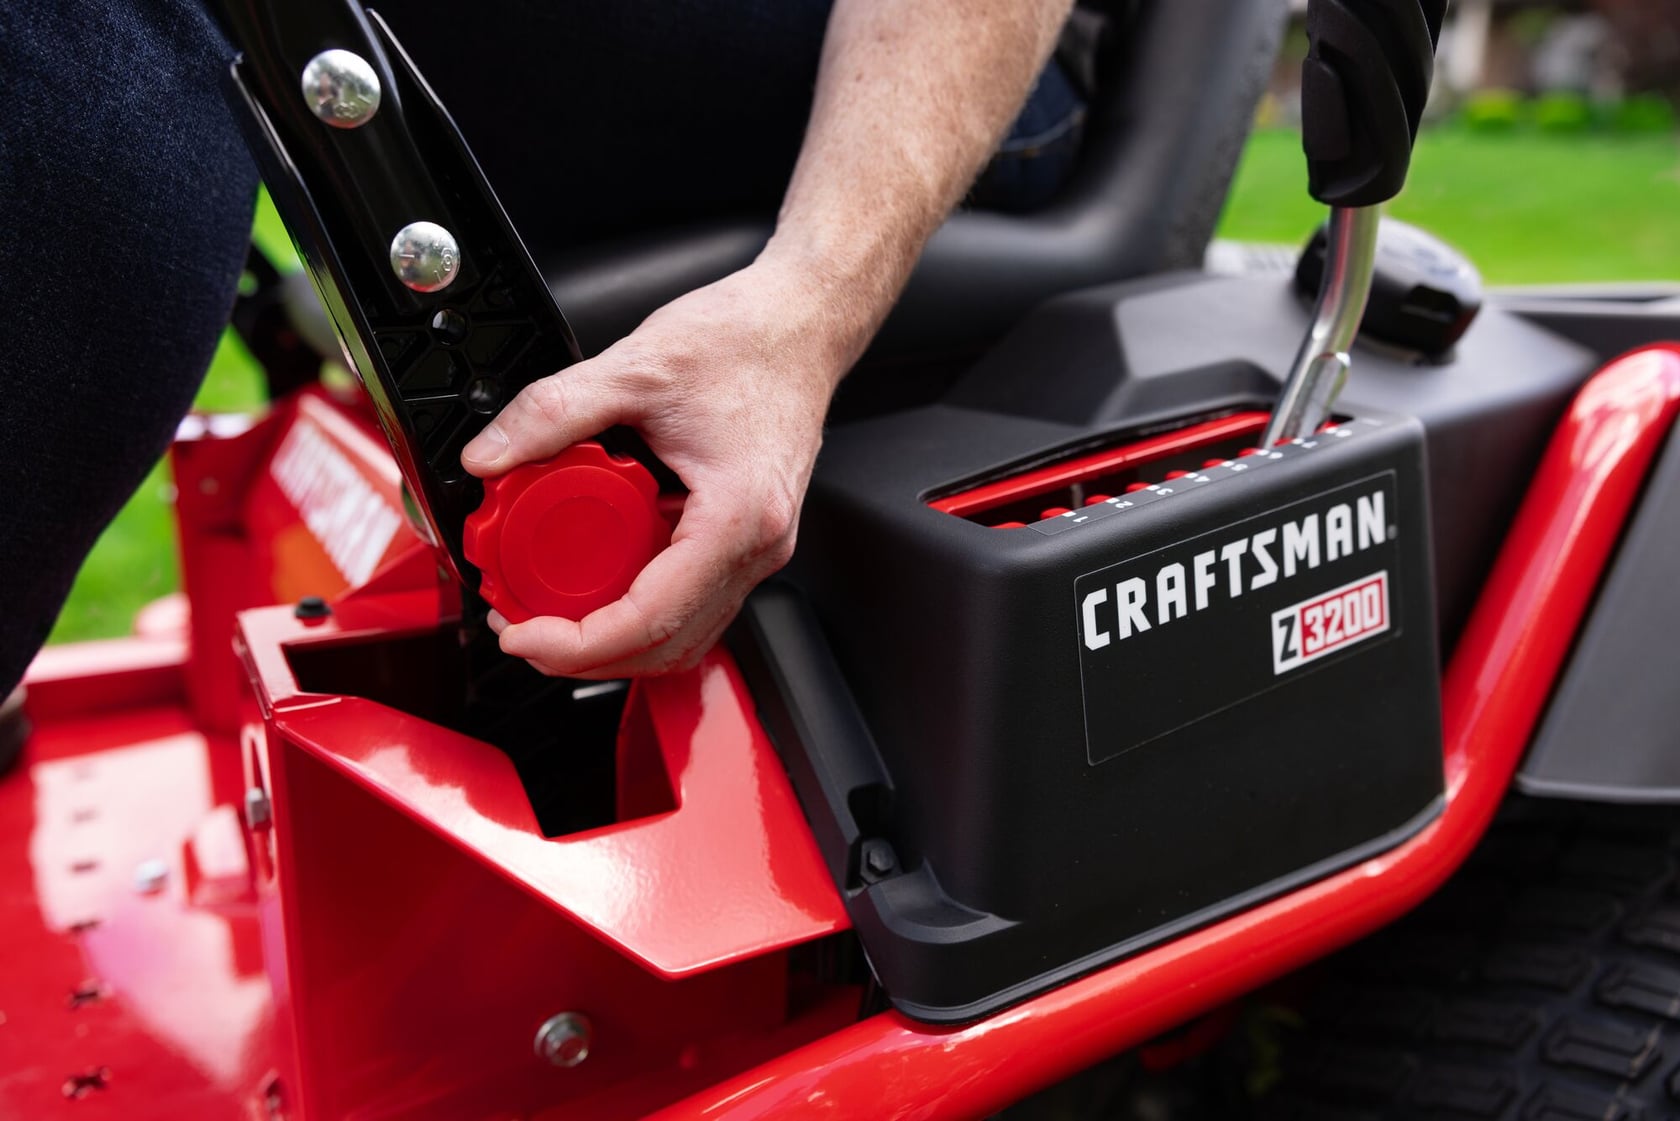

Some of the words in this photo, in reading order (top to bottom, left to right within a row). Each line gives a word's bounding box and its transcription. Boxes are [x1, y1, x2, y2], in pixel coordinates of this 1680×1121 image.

[1115, 500, 1134, 509] 2
[1156, 487, 1174, 496] 3
[1194, 475, 1210, 483] 4
[1082, 490, 1386, 650] CRAFTSMAN
[1278, 581, 1379, 664] Z3200
